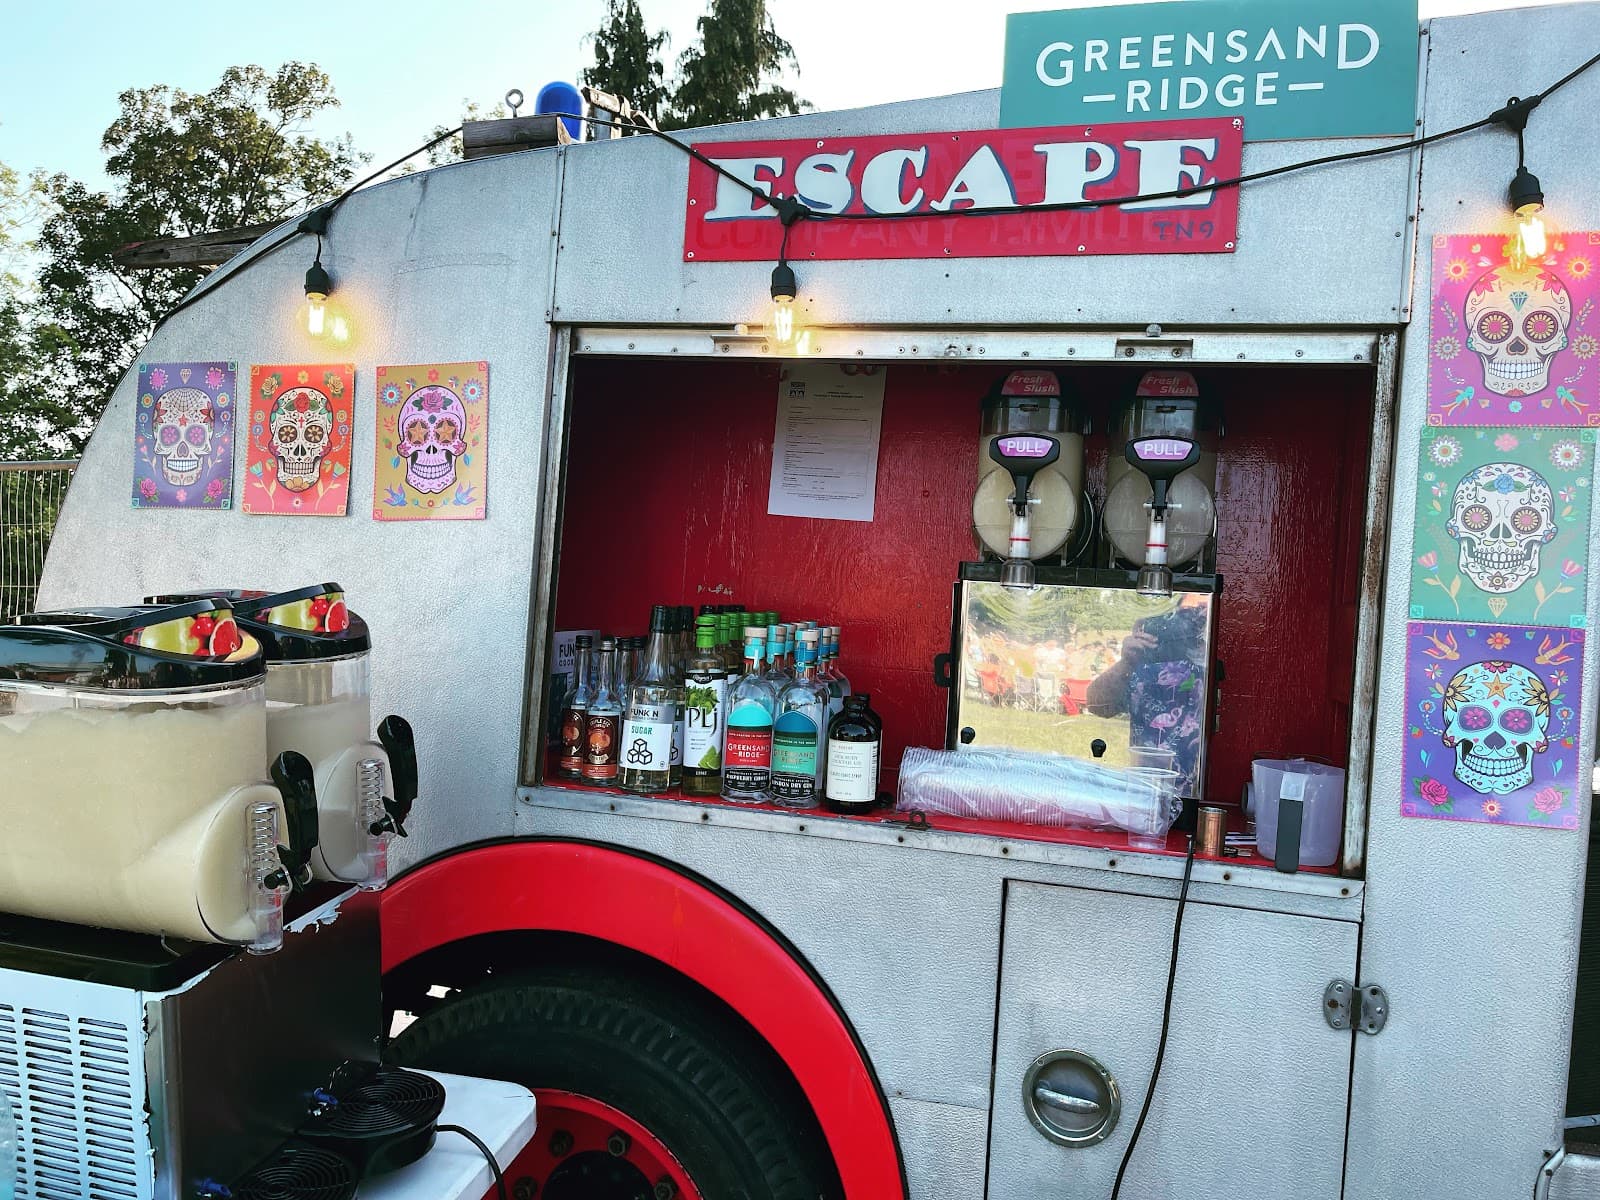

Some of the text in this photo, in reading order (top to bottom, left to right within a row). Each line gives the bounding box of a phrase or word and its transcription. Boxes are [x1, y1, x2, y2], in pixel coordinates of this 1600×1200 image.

[1035, 22, 1381, 88] GREENSAND
[1126, 70, 1280, 114] RIDGE
[704, 137, 1219, 222] ESCAPE
[1011, 374, 1044, 385] Fresh
[1145, 375, 1180, 386] Fresh
[1023, 383, 1055, 394] Slush
[1159, 384, 1193, 395] Slush
[1006, 440, 1043, 454] PULL
[1143, 443, 1183, 456] PULL
[631, 725, 652, 736] SUGAR
